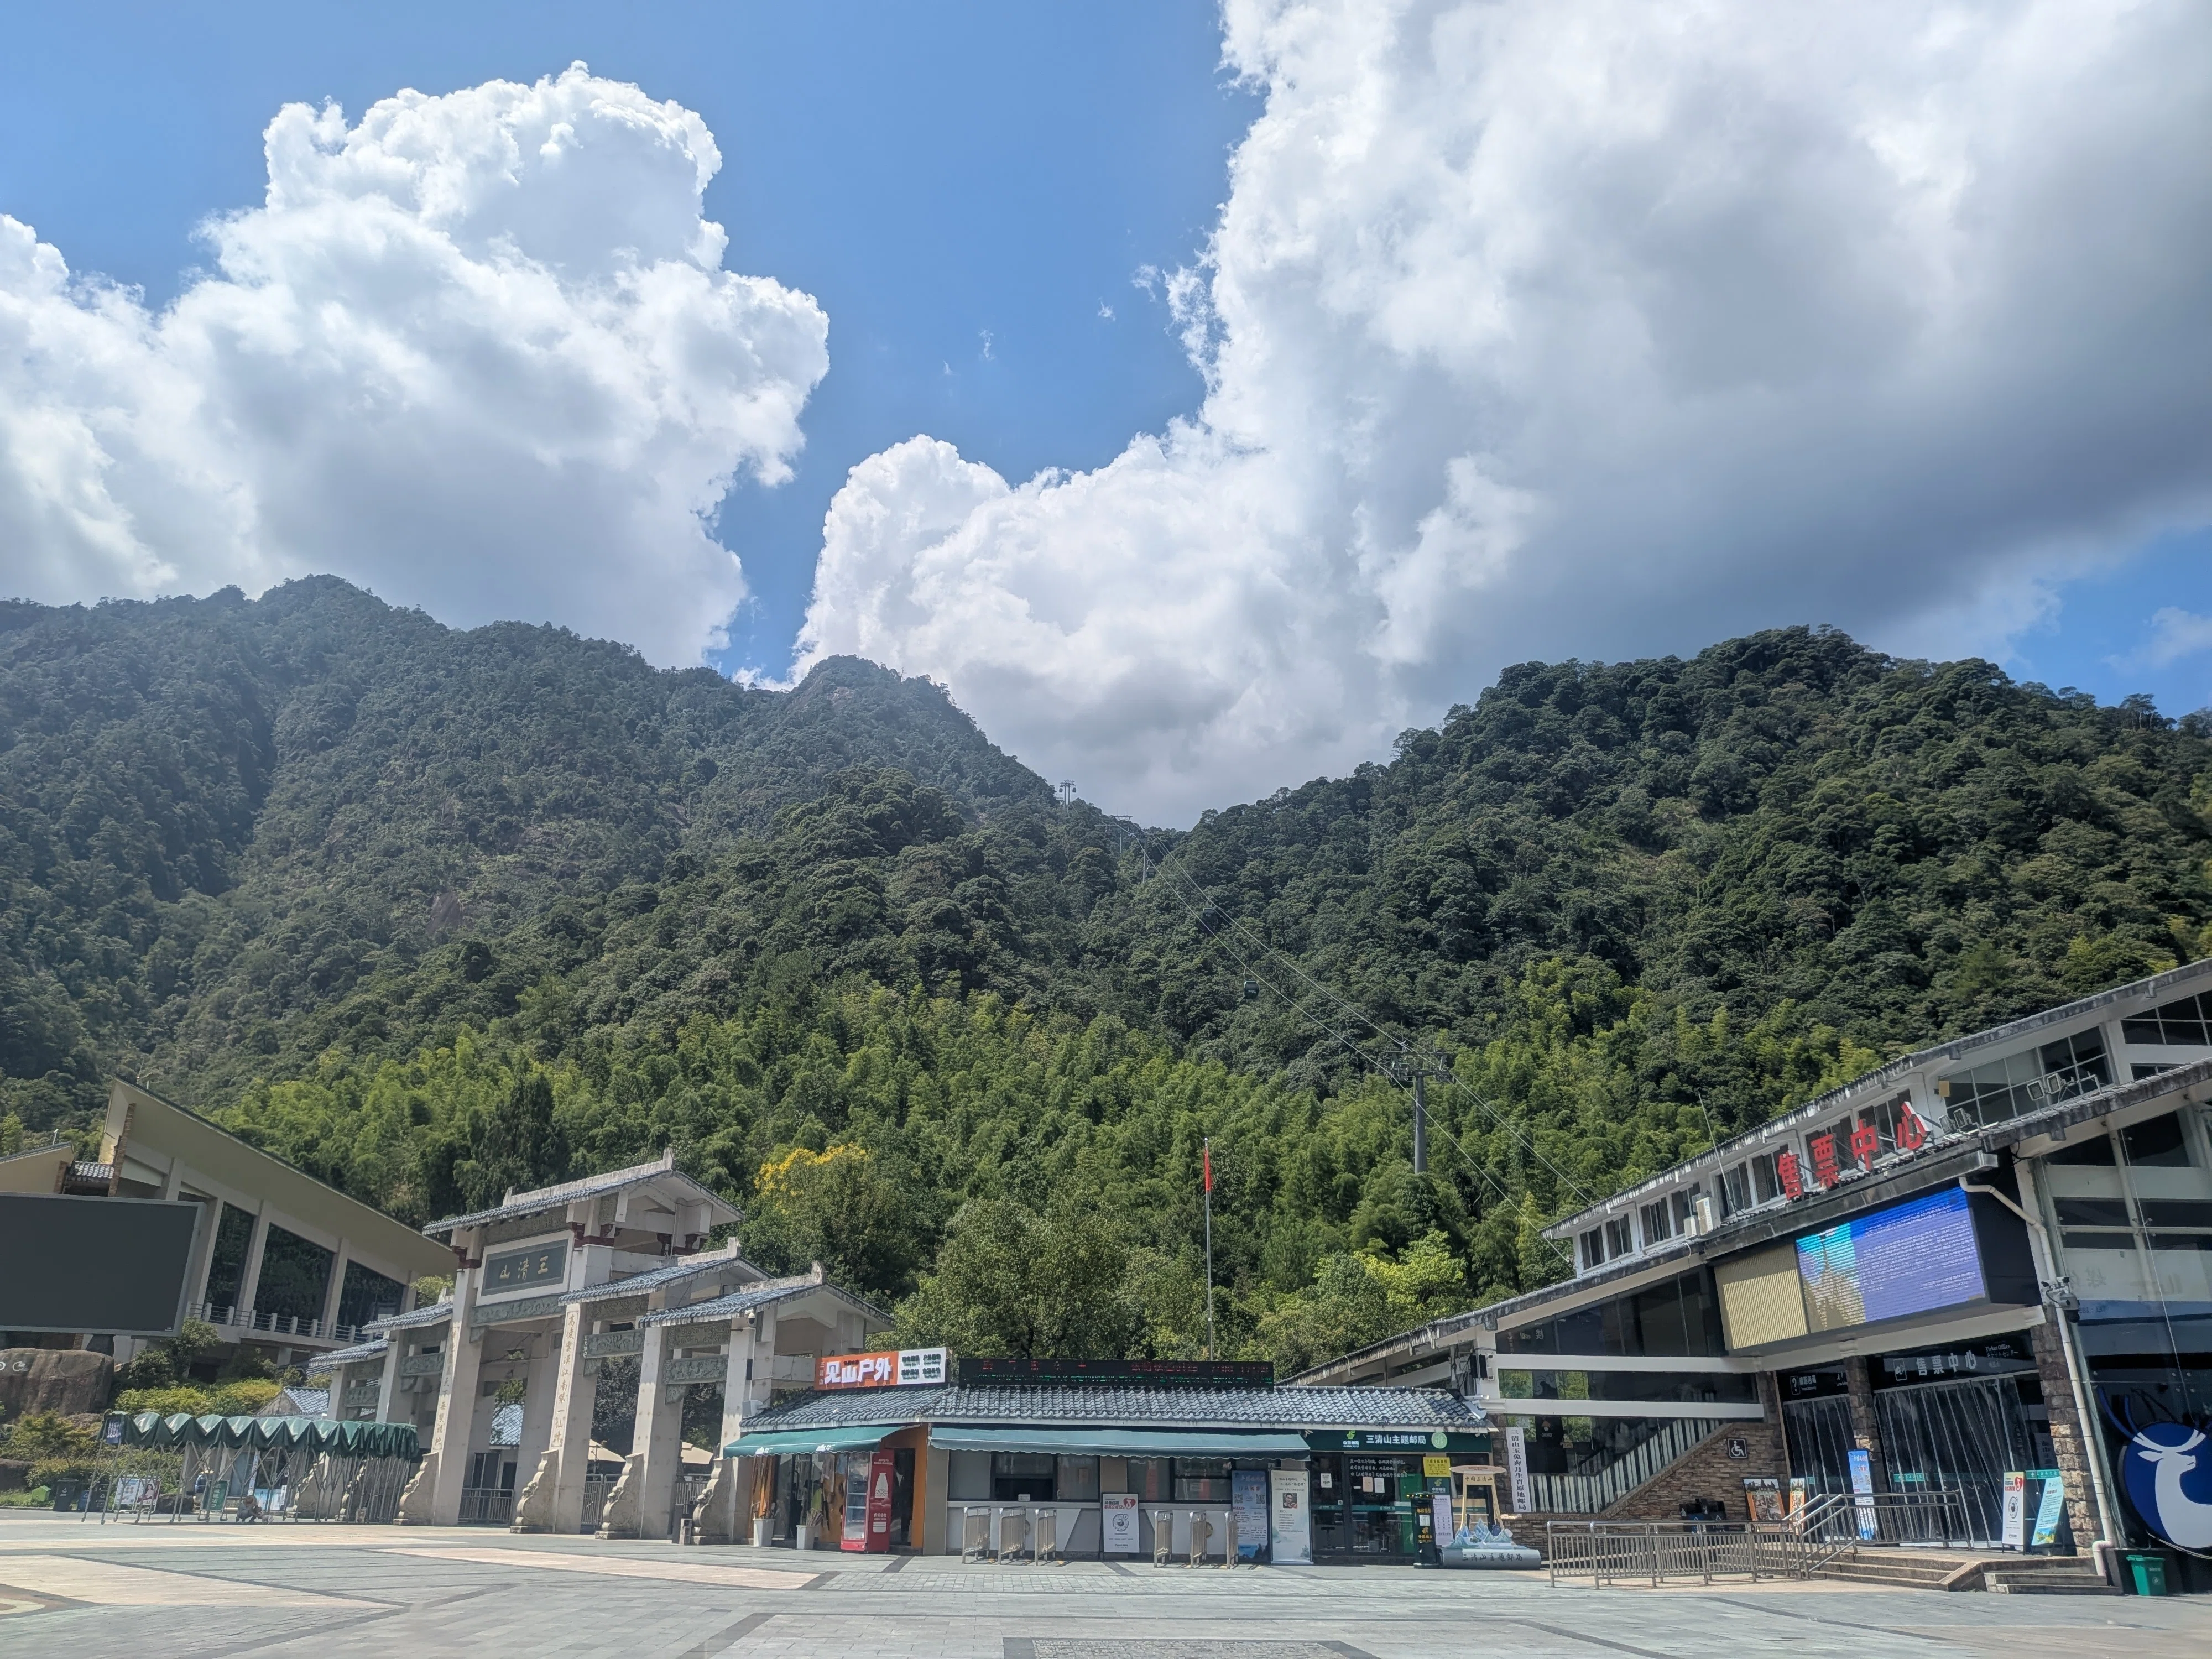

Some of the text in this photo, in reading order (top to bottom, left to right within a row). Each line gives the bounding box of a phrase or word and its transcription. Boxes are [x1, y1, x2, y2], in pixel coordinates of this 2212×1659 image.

[1778, 1101, 1930, 1200] 售票中心
[499, 1256, 549, 1280] 三清山
[825, 1357, 893, 1384] 见山户外
[1916, 1350, 1977, 1376] 售票中心
[1366, 1434, 1426, 1444] 三清山主题邮局
